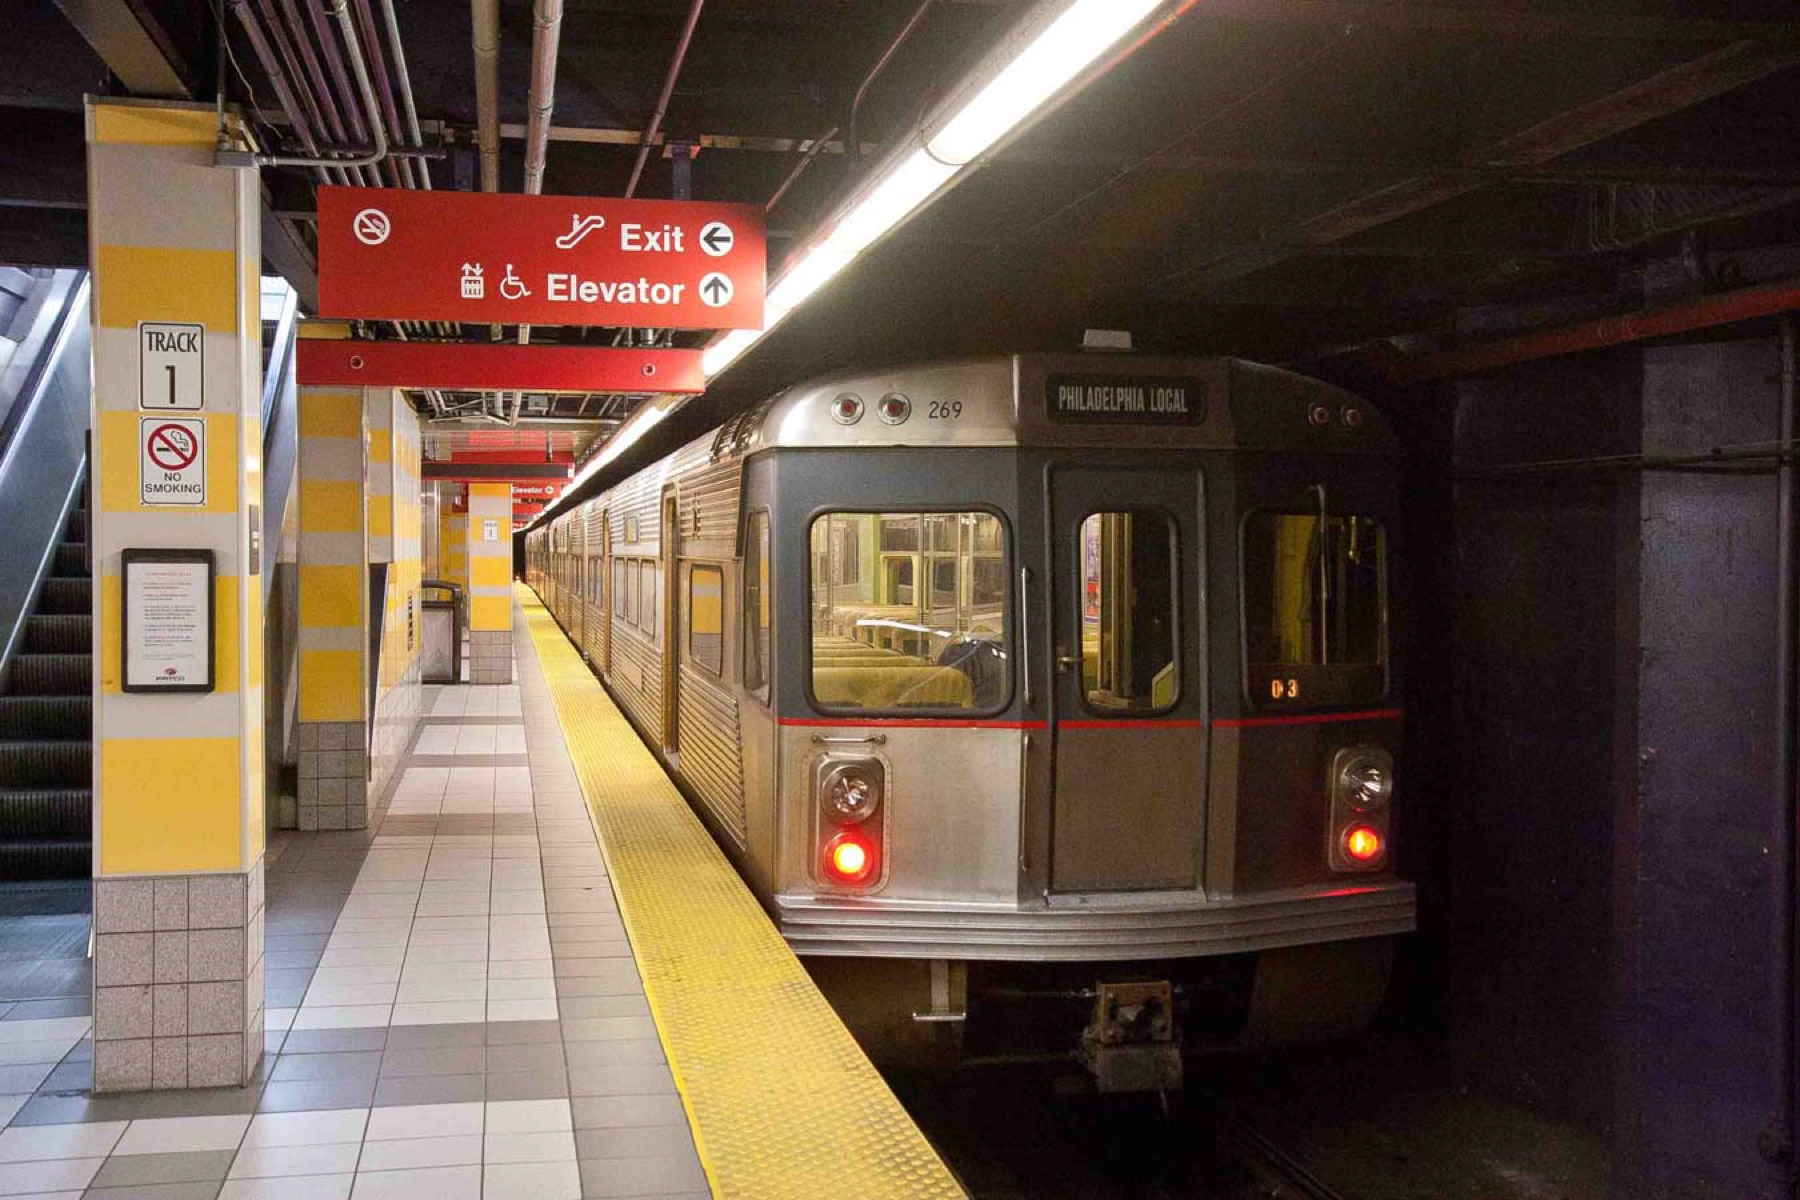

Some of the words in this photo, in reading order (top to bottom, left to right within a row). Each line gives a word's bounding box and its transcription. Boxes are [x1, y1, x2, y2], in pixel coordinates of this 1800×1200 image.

[620, 223, 685, 252] Exit
[547, 273, 686, 305] Elevator
[145, 331, 198, 353] TRACK
[165, 365, 176, 405] 1
[928, 401, 963, 419] 269
[1058, 385, 1146, 413] PHILADELPHIA
[1150, 388, 1189, 414] LOCAL
[144, 483, 202, 494] SMOKING
[164, 472, 182, 482] NO
